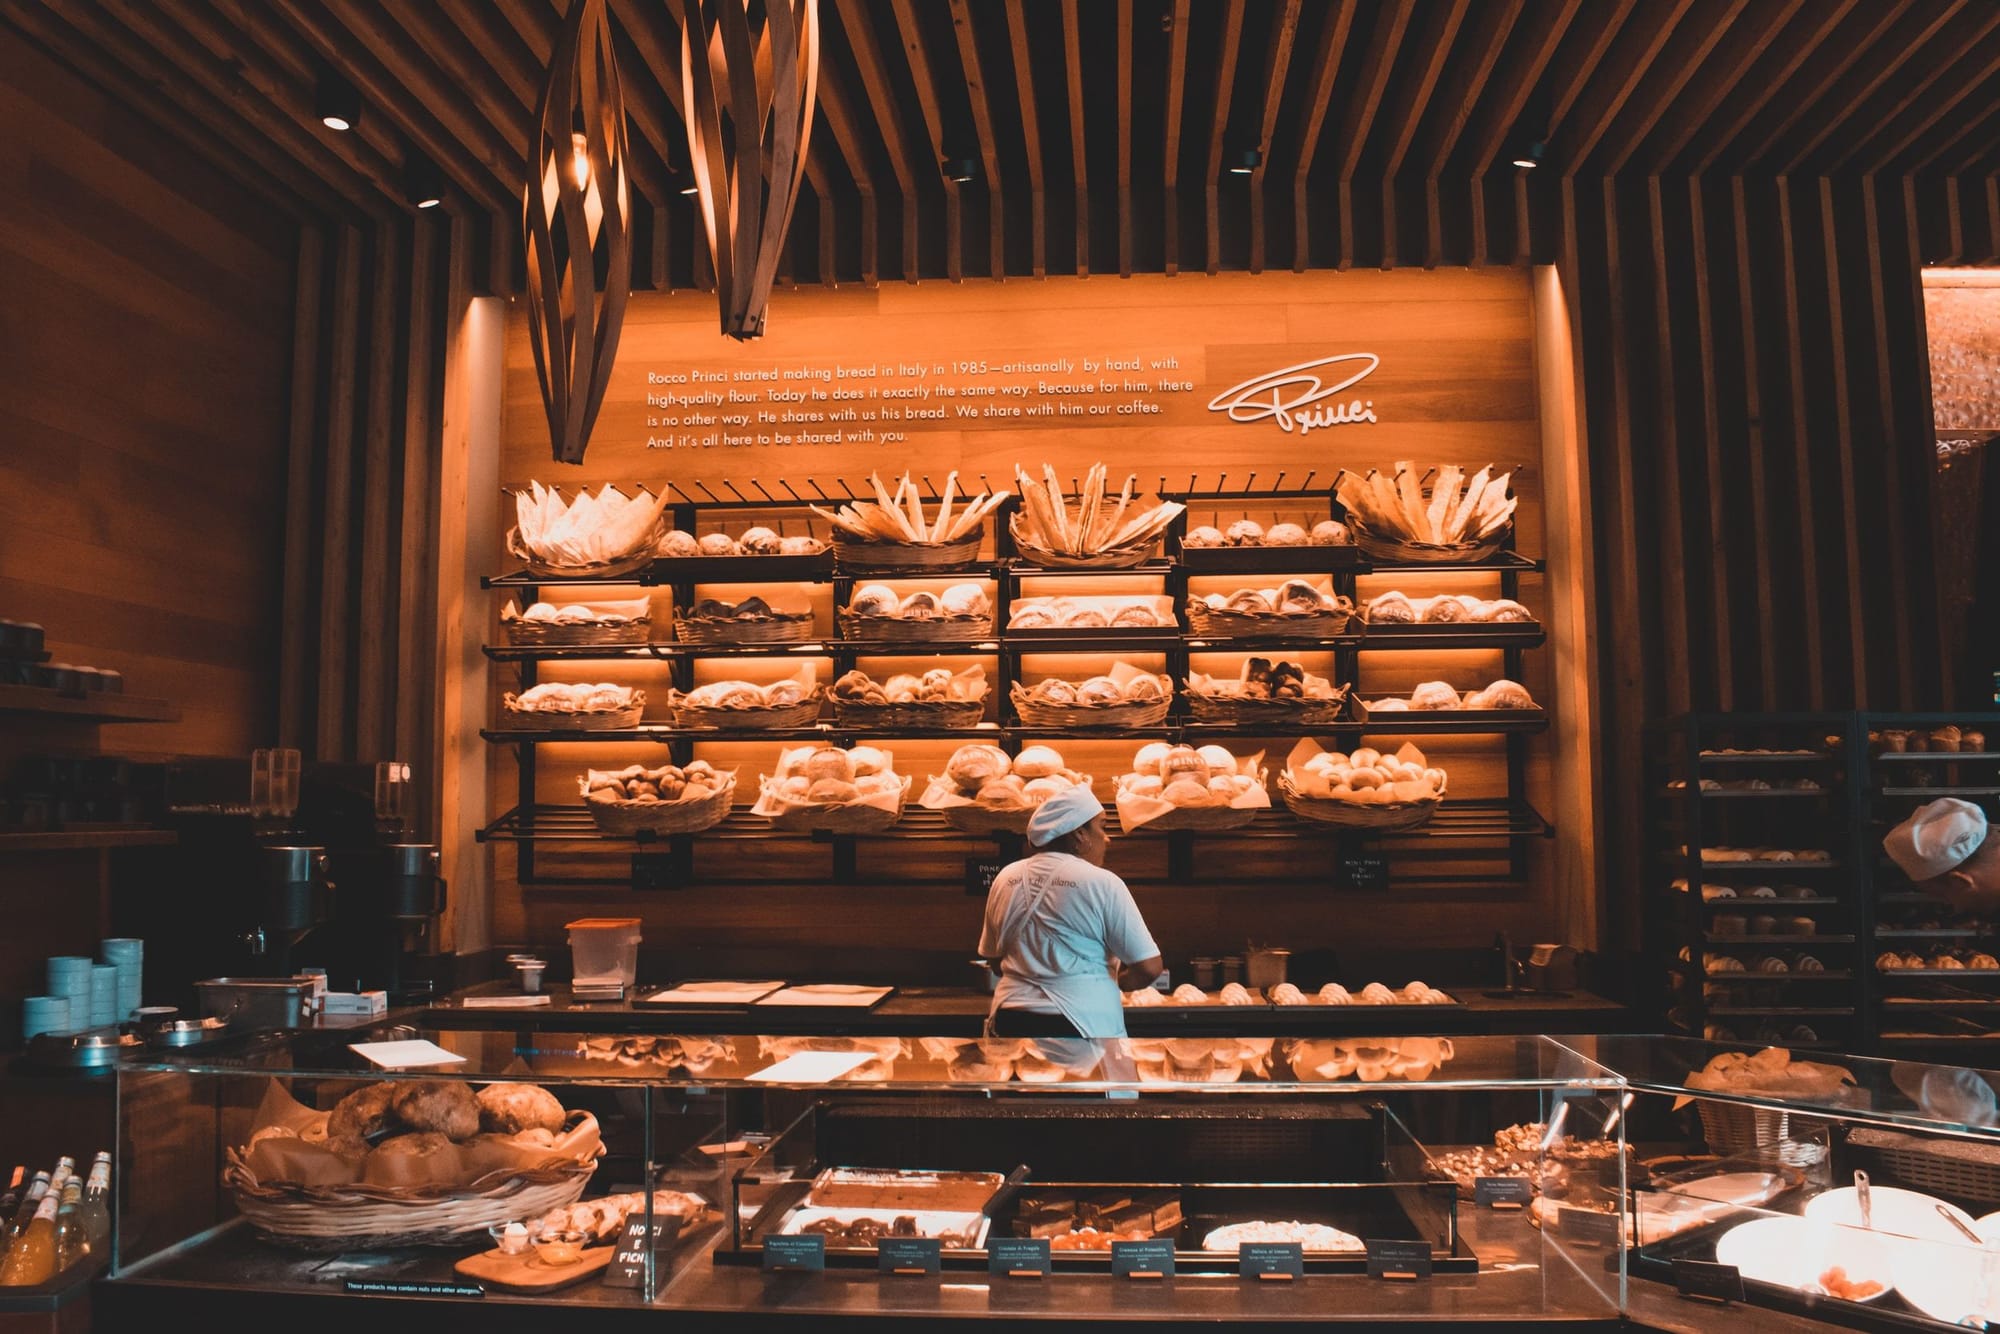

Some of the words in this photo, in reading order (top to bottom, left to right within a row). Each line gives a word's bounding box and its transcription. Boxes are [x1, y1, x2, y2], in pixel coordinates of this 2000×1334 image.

[648, 373, 687, 384] Rocco
[692, 370, 728, 383] Princi
[734, 368, 778, 381] started
[784, 366, 832, 381] making
[837, 365, 876, 378] bread
[882, 368, 893, 376] in
[899, 362, 927, 378] Italy
[933, 363, 944, 375] in
[1084, 359, 1099, 373] by
[1106, 358, 1144, 372] hand,
[1152, 357, 1178, 369] with
[648, 392, 723, 409] high-quality
[729, 390, 761, 403] flour.
[767, 389, 806, 403] Today
[812, 389, 827, 399] he
[833, 389, 864, 399] does
[870, 388, 877, 398] it
[883, 384, 930, 400] exactly
[936, 384, 955, 396] the
[961, 385, 995, 395] same
[1001, 384, 1032, 398] way.
[1038, 381, 1094, 395] Because
[1099, 379, 1118, 392] for
[1124, 379, 1152, 393] him,
[1159, 380, 1193, 391] there
[648, 416, 657, 427] is
[663, 417, 678, 426] no
[683, 414, 717, 426] other
[722, 415, 751, 427] way.
[759, 412, 776, 423] He
[782, 411, 823, 423] shares
[829, 409, 856, 421] with
[862, 412, 875, 420] us
[882, 408, 900, 420] his
[906, 406, 949, 420] bread.
[956, 406, 978, 418] We
[984, 404, 1020, 416] share
[1026, 403, 1053, 415] with
[1060, 403, 1083, 415] him
[1089, 404, 1111, 413] our
[1117, 400, 1163, 414] coffee.
[647, 436, 673, 448] And
[703, 434, 717, 446] all
[724, 433, 751, 445] here
[757, 434, 769, 444] to
[775, 432, 791, 444] be
[797, 431, 841, 443] shared
[847, 430, 874, 441] with
[880, 430, 908, 444] you.
[633, 1239, 642, 1250] E
[619, 1252, 646, 1264] FICH
[363, 1283, 386, 1291] products
